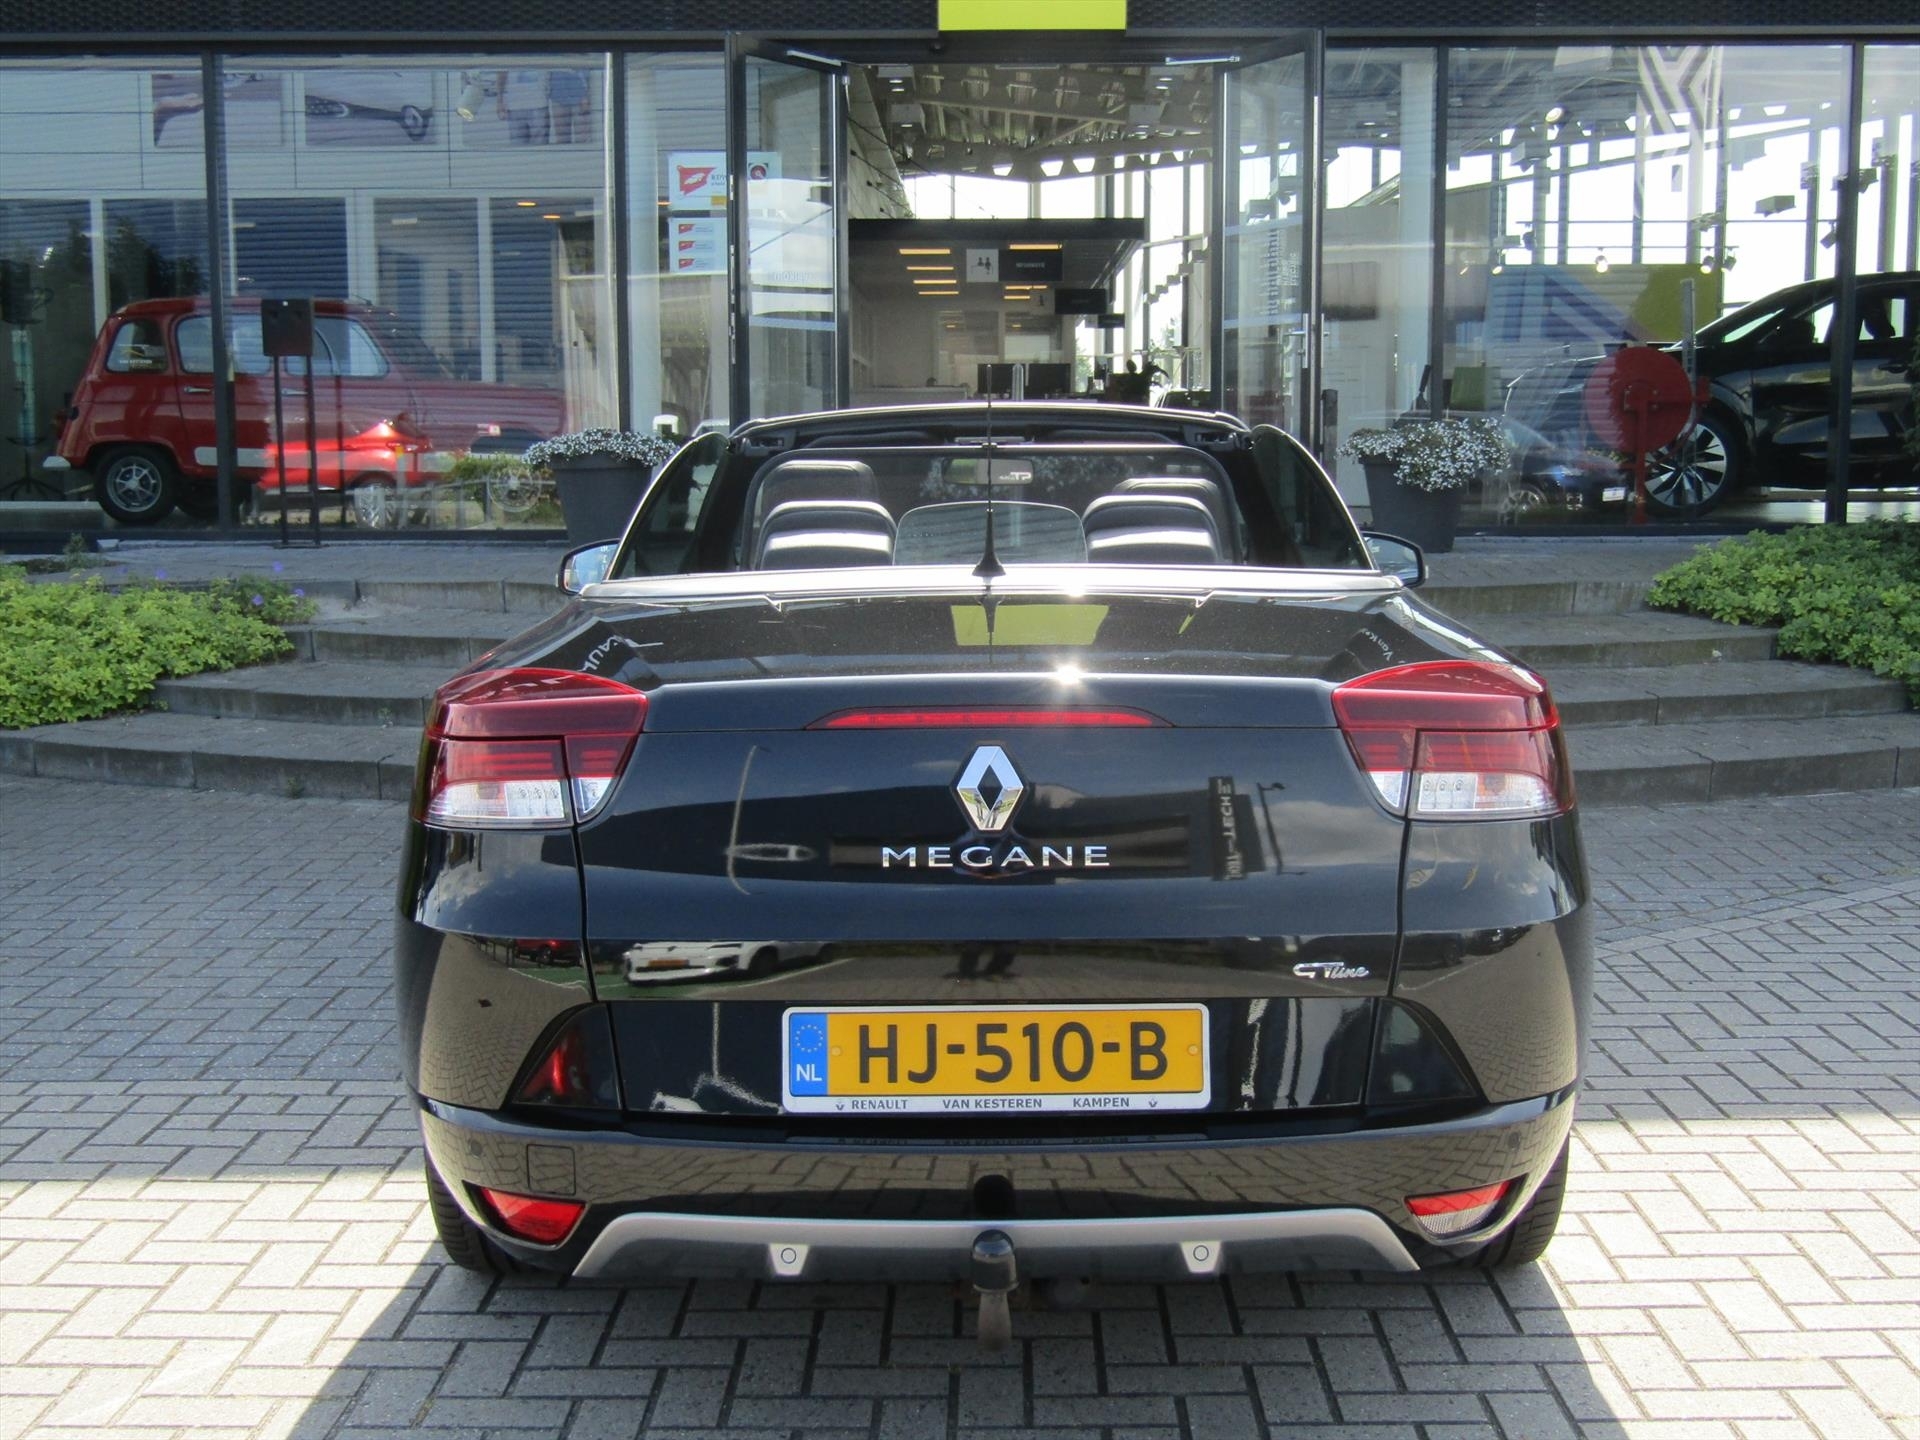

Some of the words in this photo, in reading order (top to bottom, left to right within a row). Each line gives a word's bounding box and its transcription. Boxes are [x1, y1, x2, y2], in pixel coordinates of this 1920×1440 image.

[882, 845, 1110, 868] MEGANE
[858, 1021, 1168, 1084] HJ-510-B
[796, 1063, 823, 1082] NL
[851, 1099, 909, 1110] RENAULT
[942, 1098, 970, 1109] VAN
[974, 1097, 1042, 1109] KESTEREN
[1072, 1096, 1130, 1108] KAMPEN
